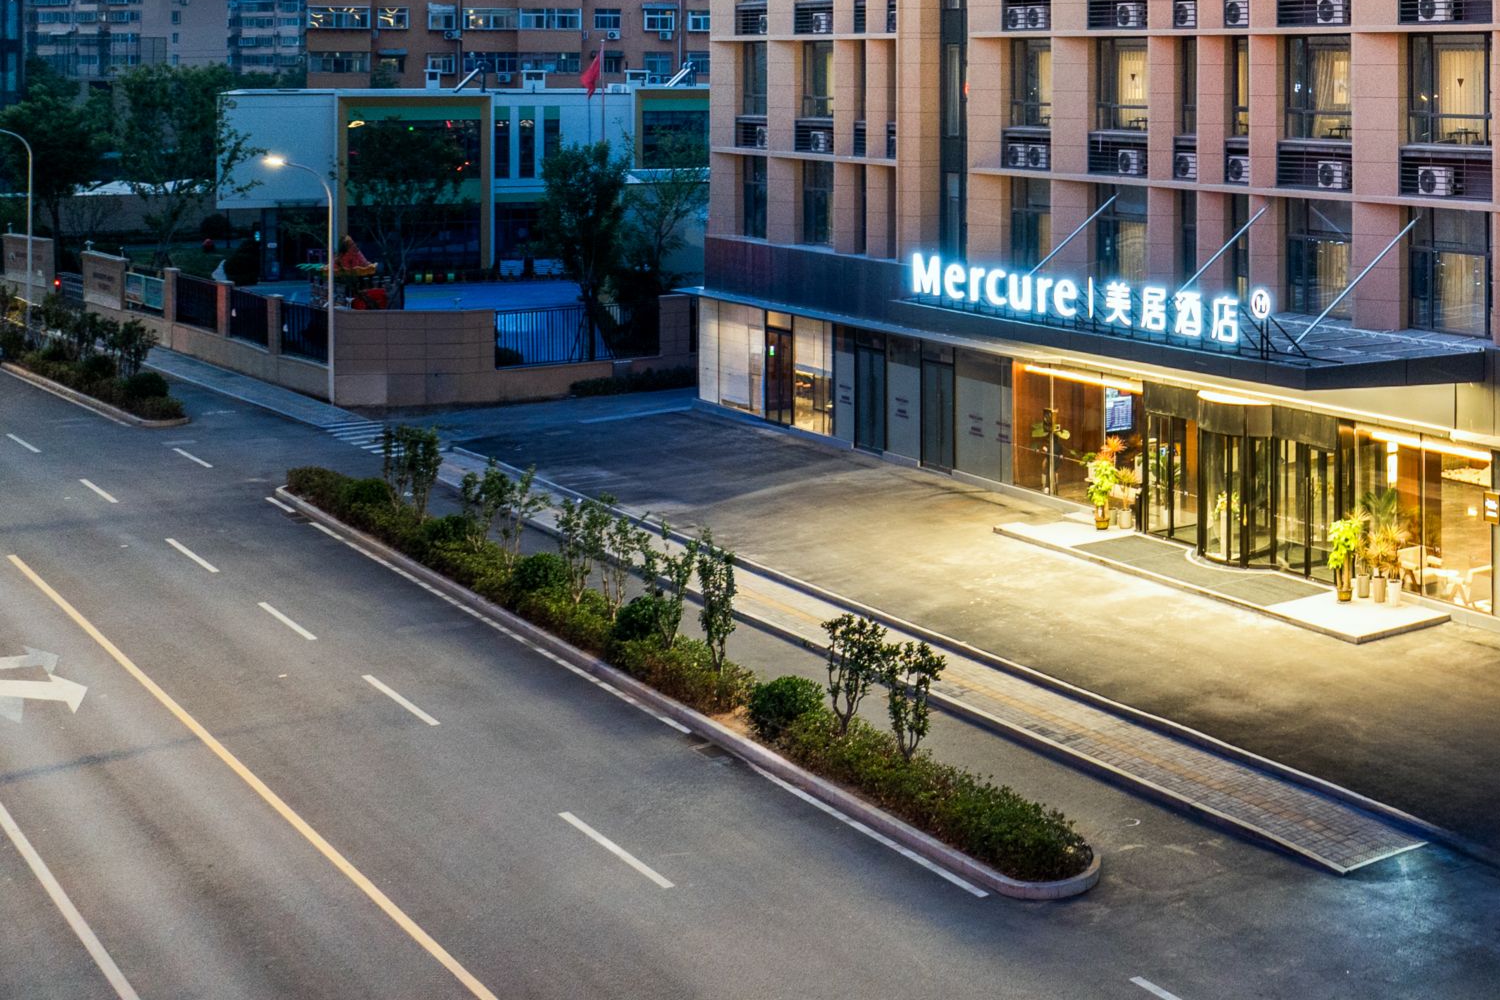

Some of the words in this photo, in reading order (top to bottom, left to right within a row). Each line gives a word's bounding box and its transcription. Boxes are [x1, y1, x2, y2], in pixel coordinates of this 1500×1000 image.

[912, 252, 1078, 317] Mercure
[1106, 282, 1238, 343] 美居酒店
